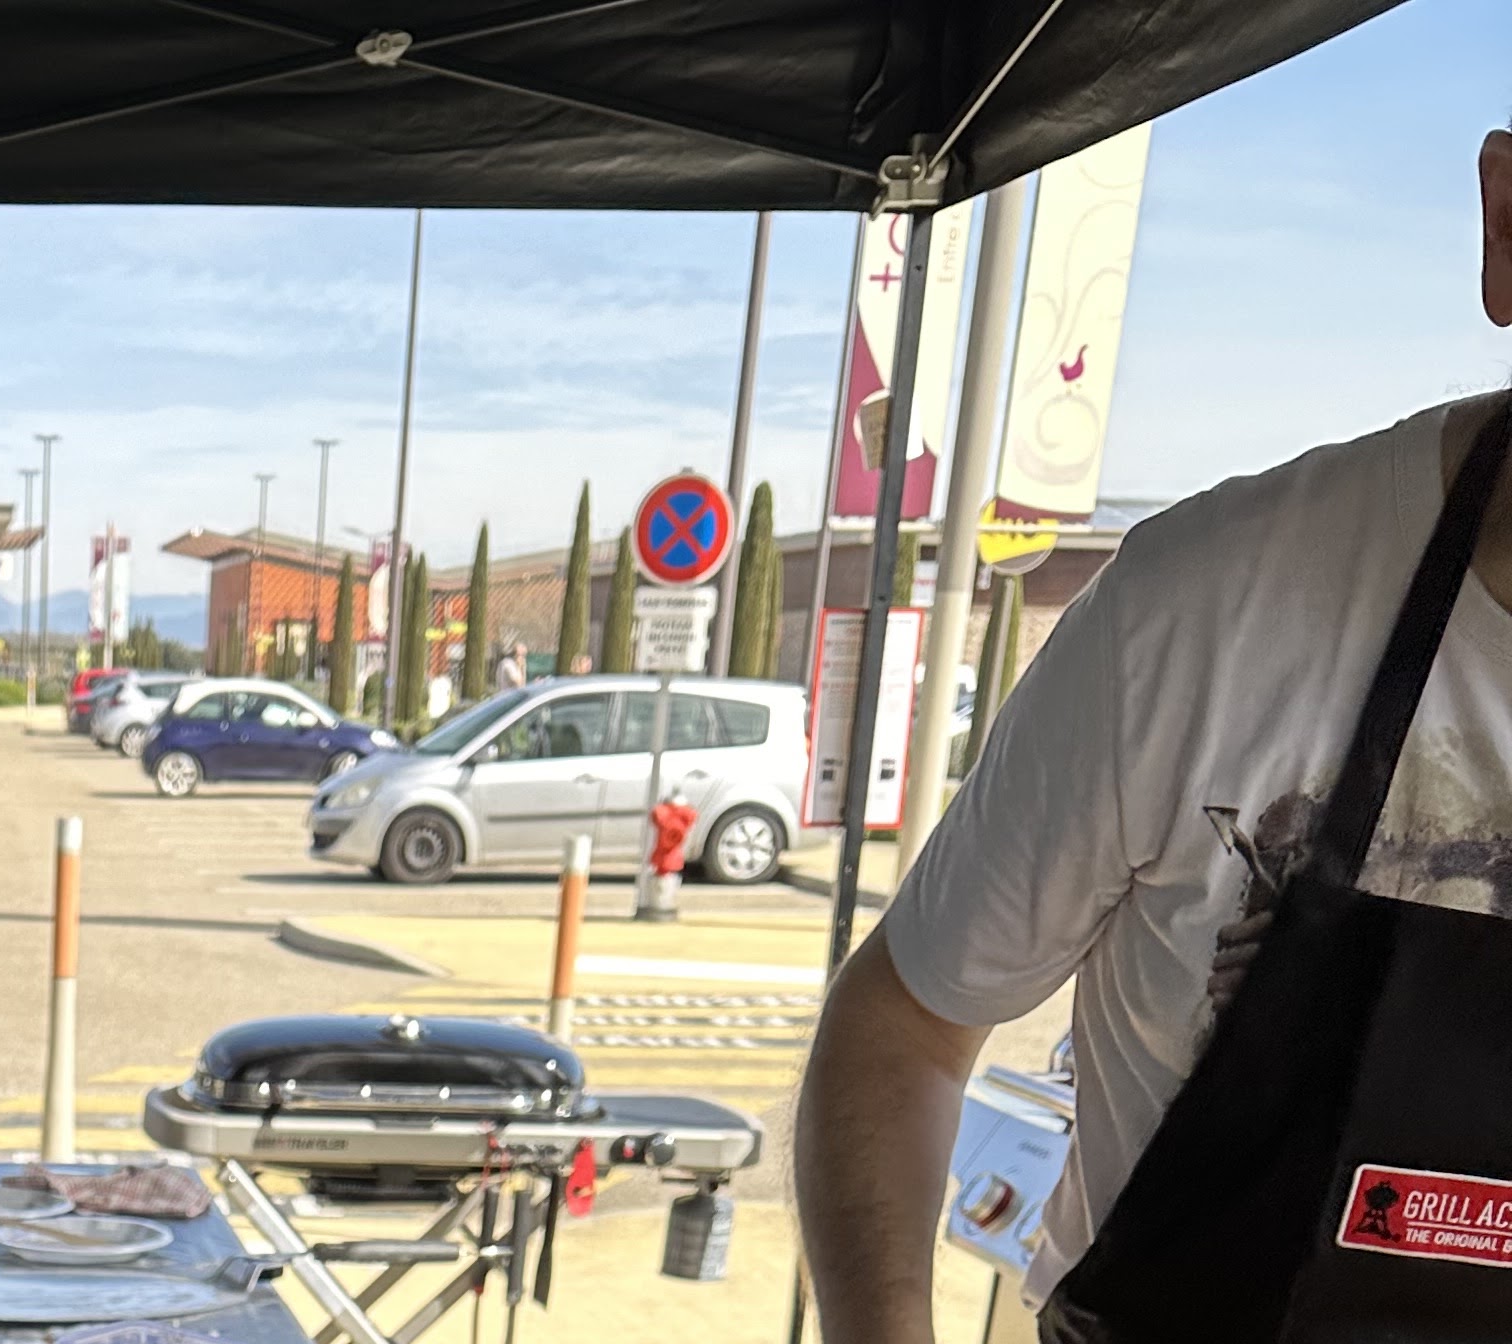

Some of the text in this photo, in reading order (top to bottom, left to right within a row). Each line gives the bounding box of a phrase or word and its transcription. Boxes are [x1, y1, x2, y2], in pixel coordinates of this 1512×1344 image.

[1402, 1190, 1512, 1230] GRILL AC
[1405, 1228, 1432, 1244] THE
[1434, 1231, 1498, 1252] ORIGINAL
